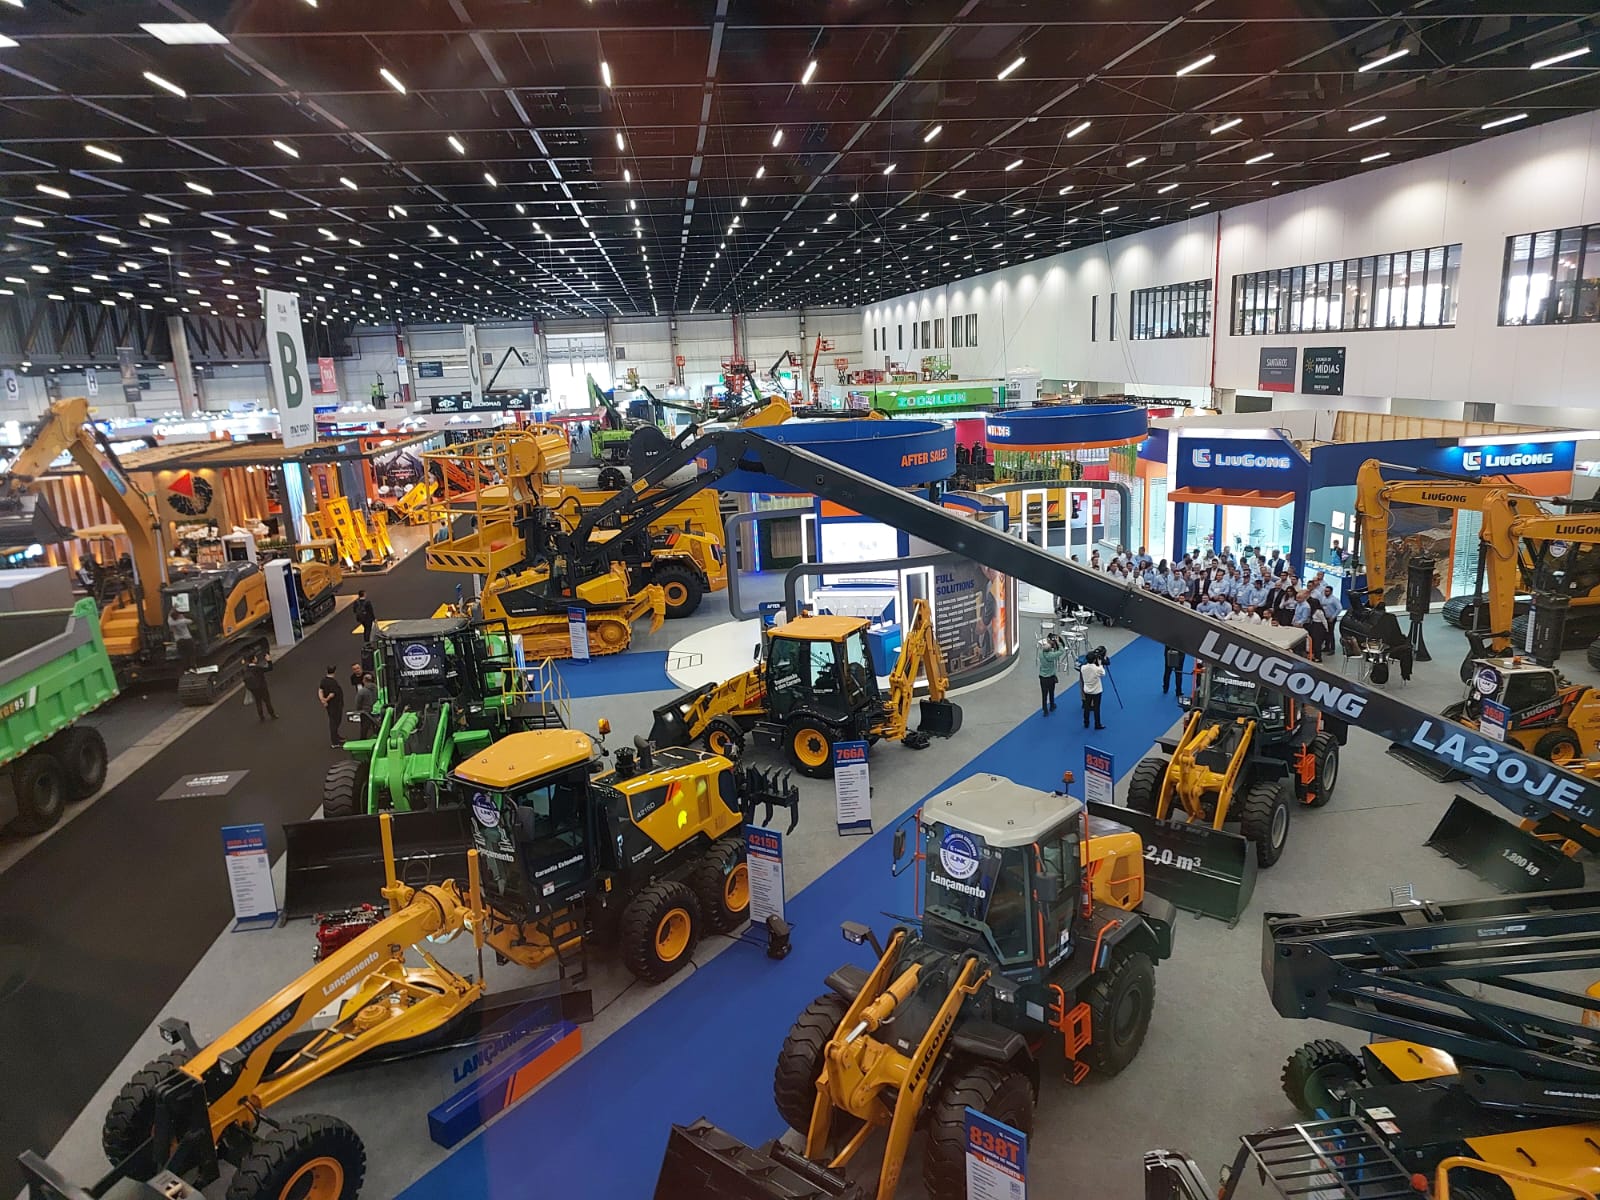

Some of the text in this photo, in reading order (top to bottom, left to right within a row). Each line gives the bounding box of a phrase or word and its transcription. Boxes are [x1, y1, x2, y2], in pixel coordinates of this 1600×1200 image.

[276, 331, 303, 409] B
[1315, 361, 1340, 374] MÍDIAS
[6, 377, 16, 393] G
[88, 375, 98, 389] H
[901, 448, 948, 467] AFTER SALES
[1215, 453, 1291, 469] LIUGONG
[1486, 453, 1553, 467] LIUGONG
[1421, 491, 1467, 503] LIUGONG
[936, 573, 954, 584] FULL
[936, 579, 974, 596] SOLUTIONS
[1199, 630, 1368, 718] LIUGONG
[836, 748, 865, 760] 766A
[637, 802, 656, 818] 4215D
[749, 834, 778, 849] 4215D
[1146, 845, 1173, 865] 2,0
[1502, 848, 1540, 876] 1.800 kg
[931, 871, 986, 898] Lançamento
[322, 951, 379, 996] Lançamento
[909, 1012, 952, 1093] LIUGONG
[970, 1125, 1020, 1163] 838T
